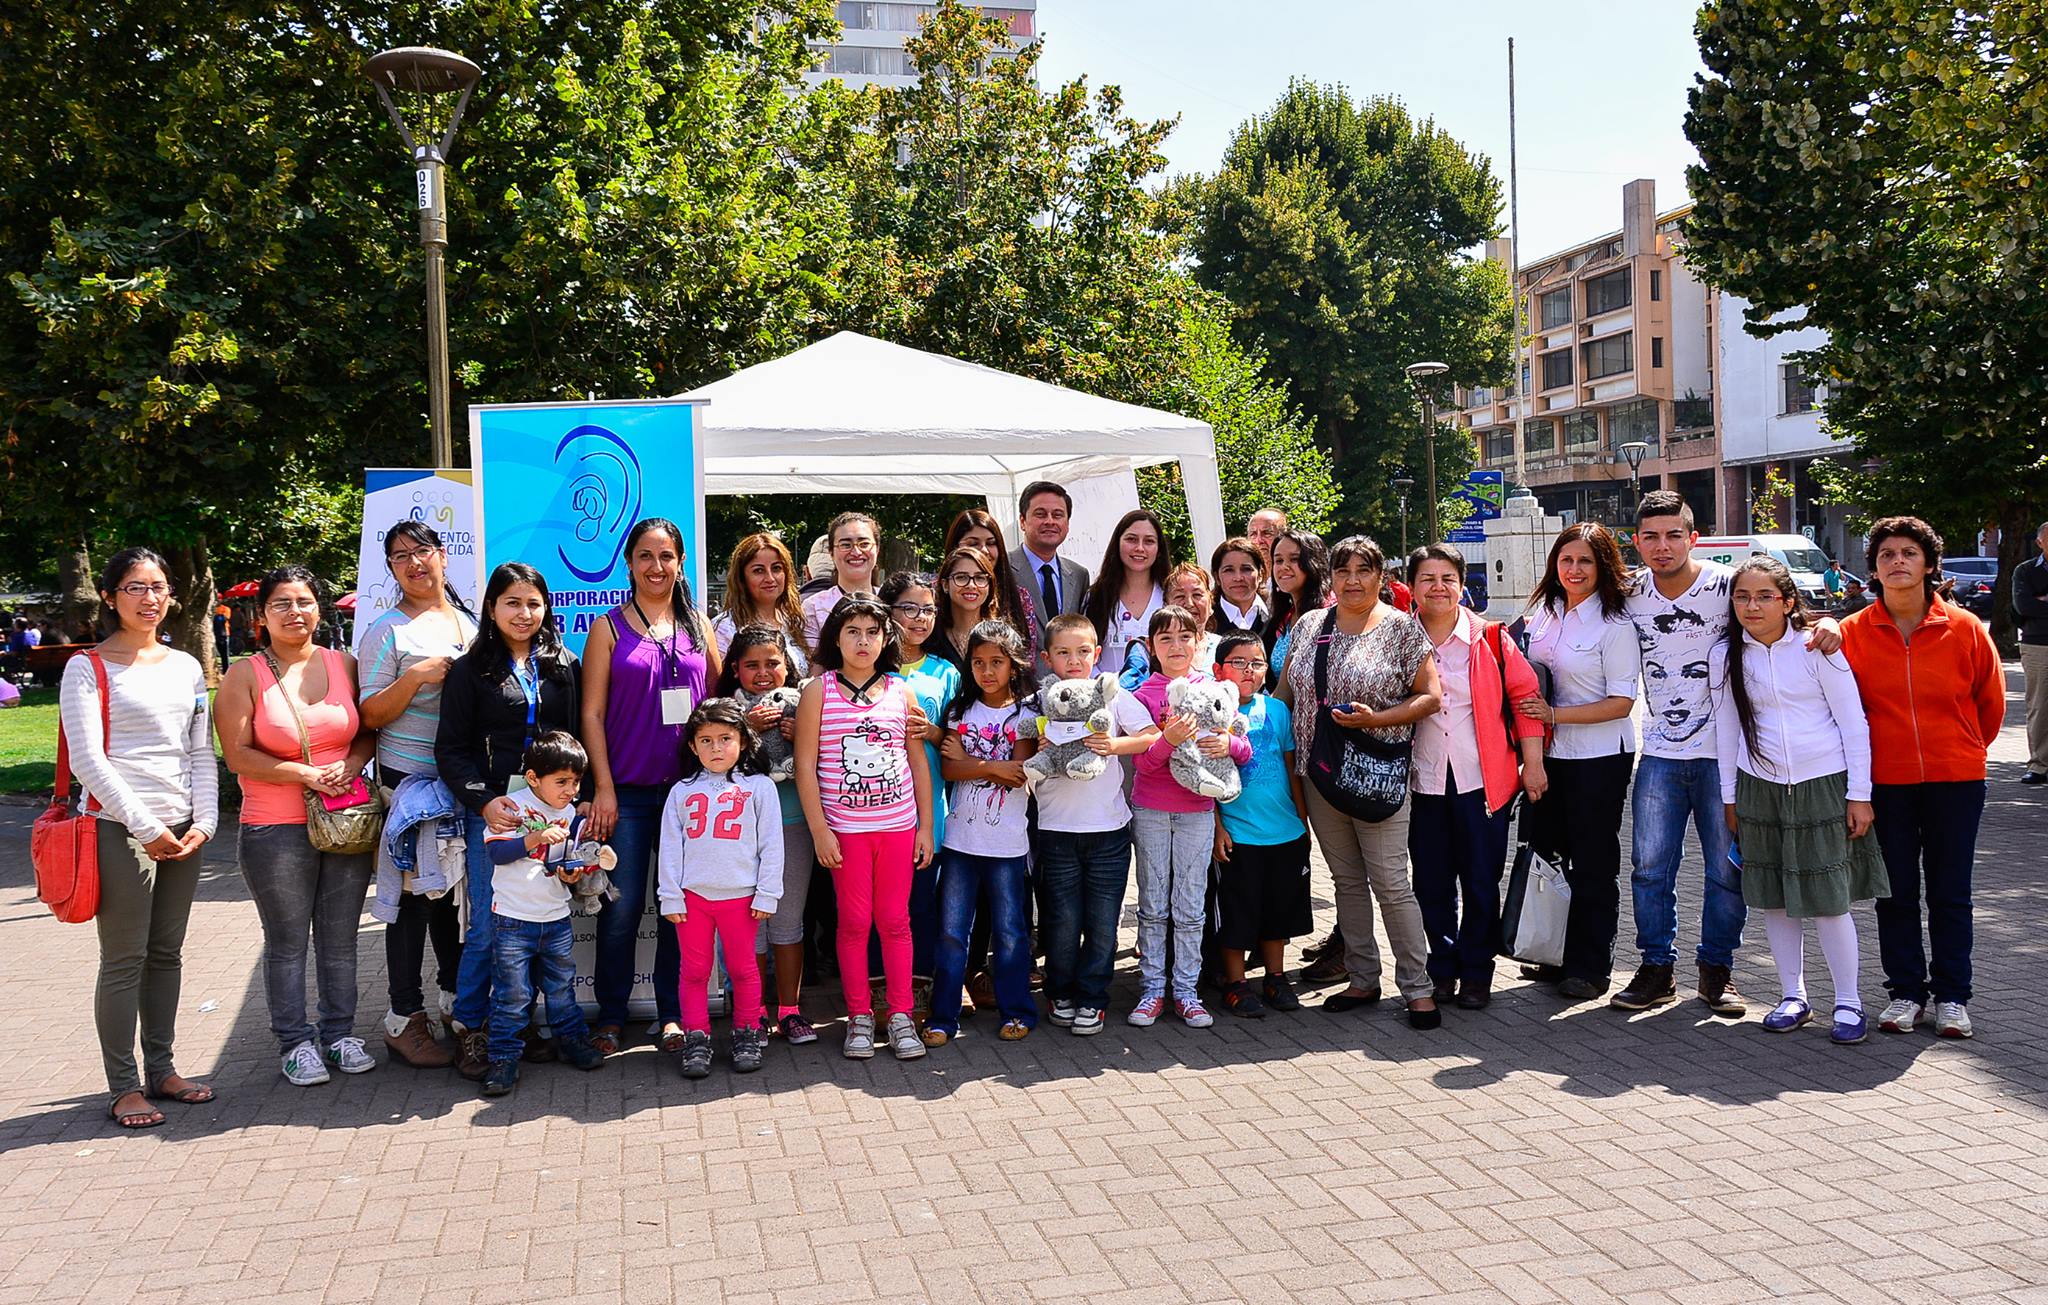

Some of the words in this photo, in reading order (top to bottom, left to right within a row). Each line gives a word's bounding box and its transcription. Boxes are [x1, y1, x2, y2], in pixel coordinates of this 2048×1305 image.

[419, 170, 427, 207] 026
[837, 787, 902, 809] QUEEN
[838, 781, 843, 794] I
[847, 781, 872, 794] AM
[875, 777, 902, 793] THE
[684, 790, 744, 840] 32
